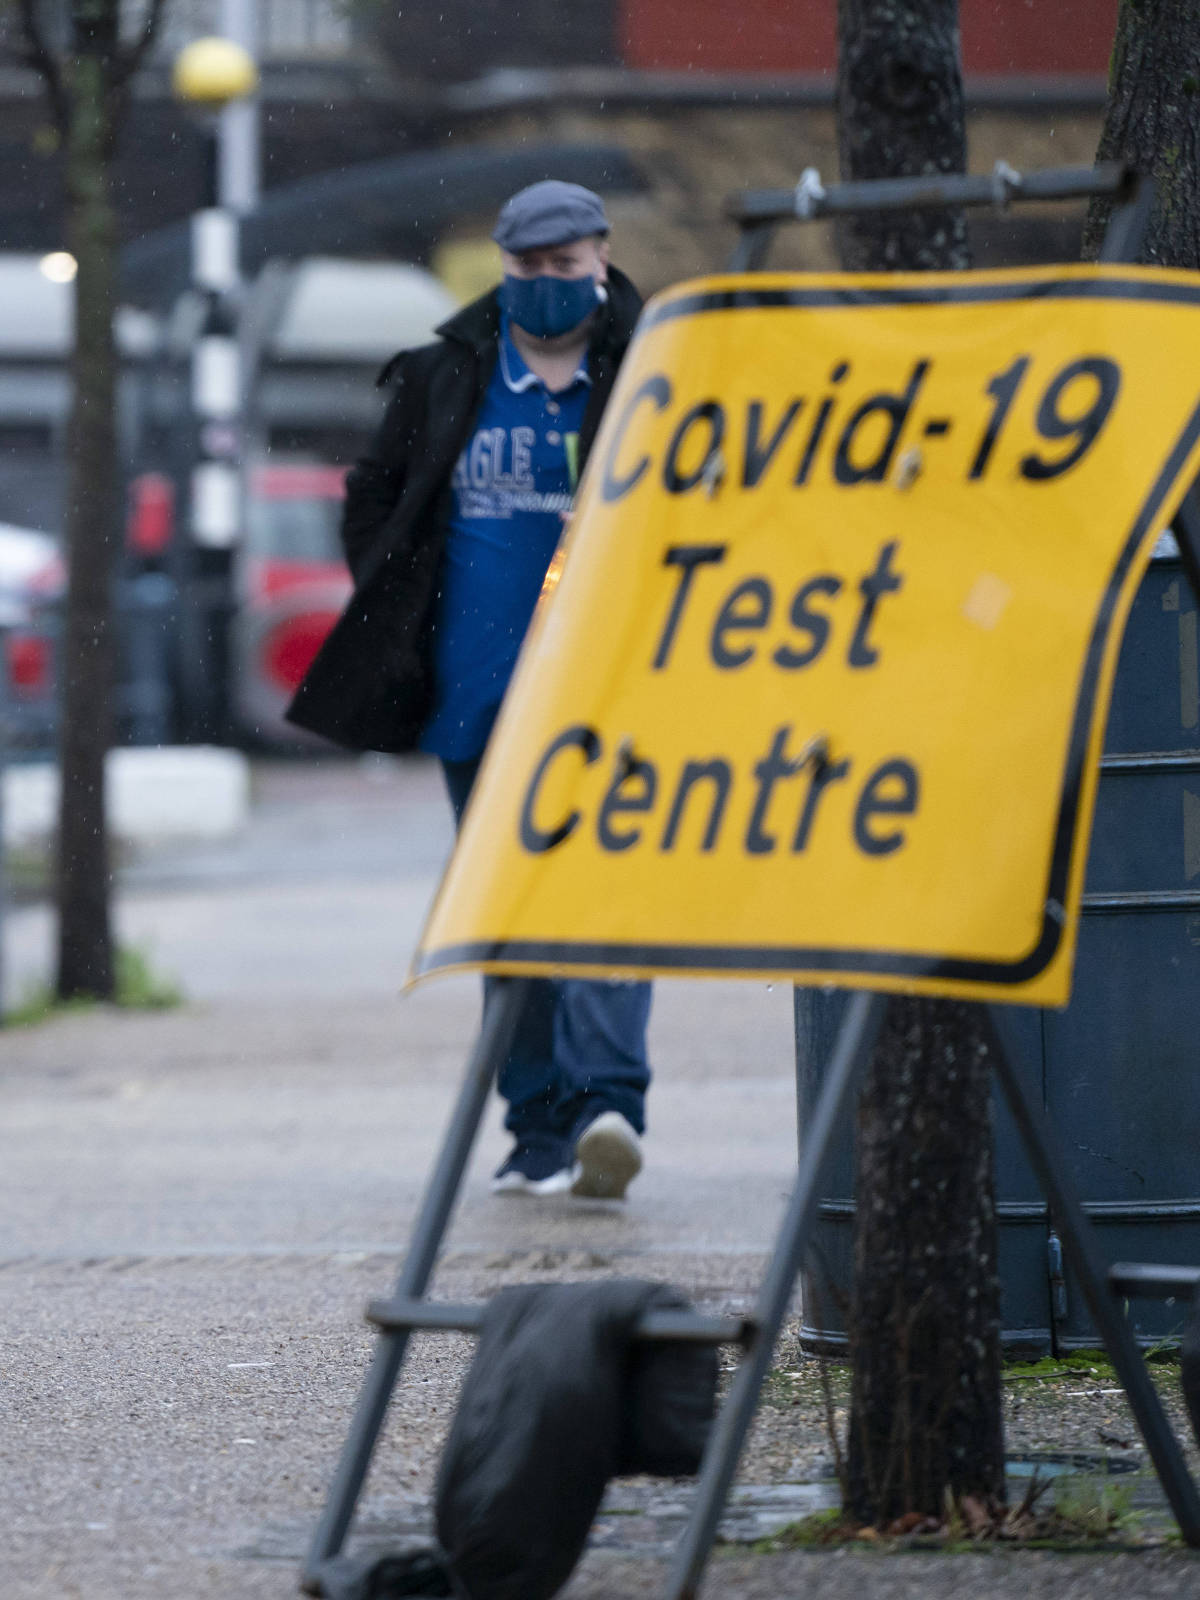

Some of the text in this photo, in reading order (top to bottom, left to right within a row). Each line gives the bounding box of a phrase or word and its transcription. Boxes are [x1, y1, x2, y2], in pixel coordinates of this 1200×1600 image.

[452, 427, 536, 490] AGLE
[601, 354, 1122, 505] Covid-19
[650, 540, 903, 673] Test
[518, 723, 921, 857] Centre
